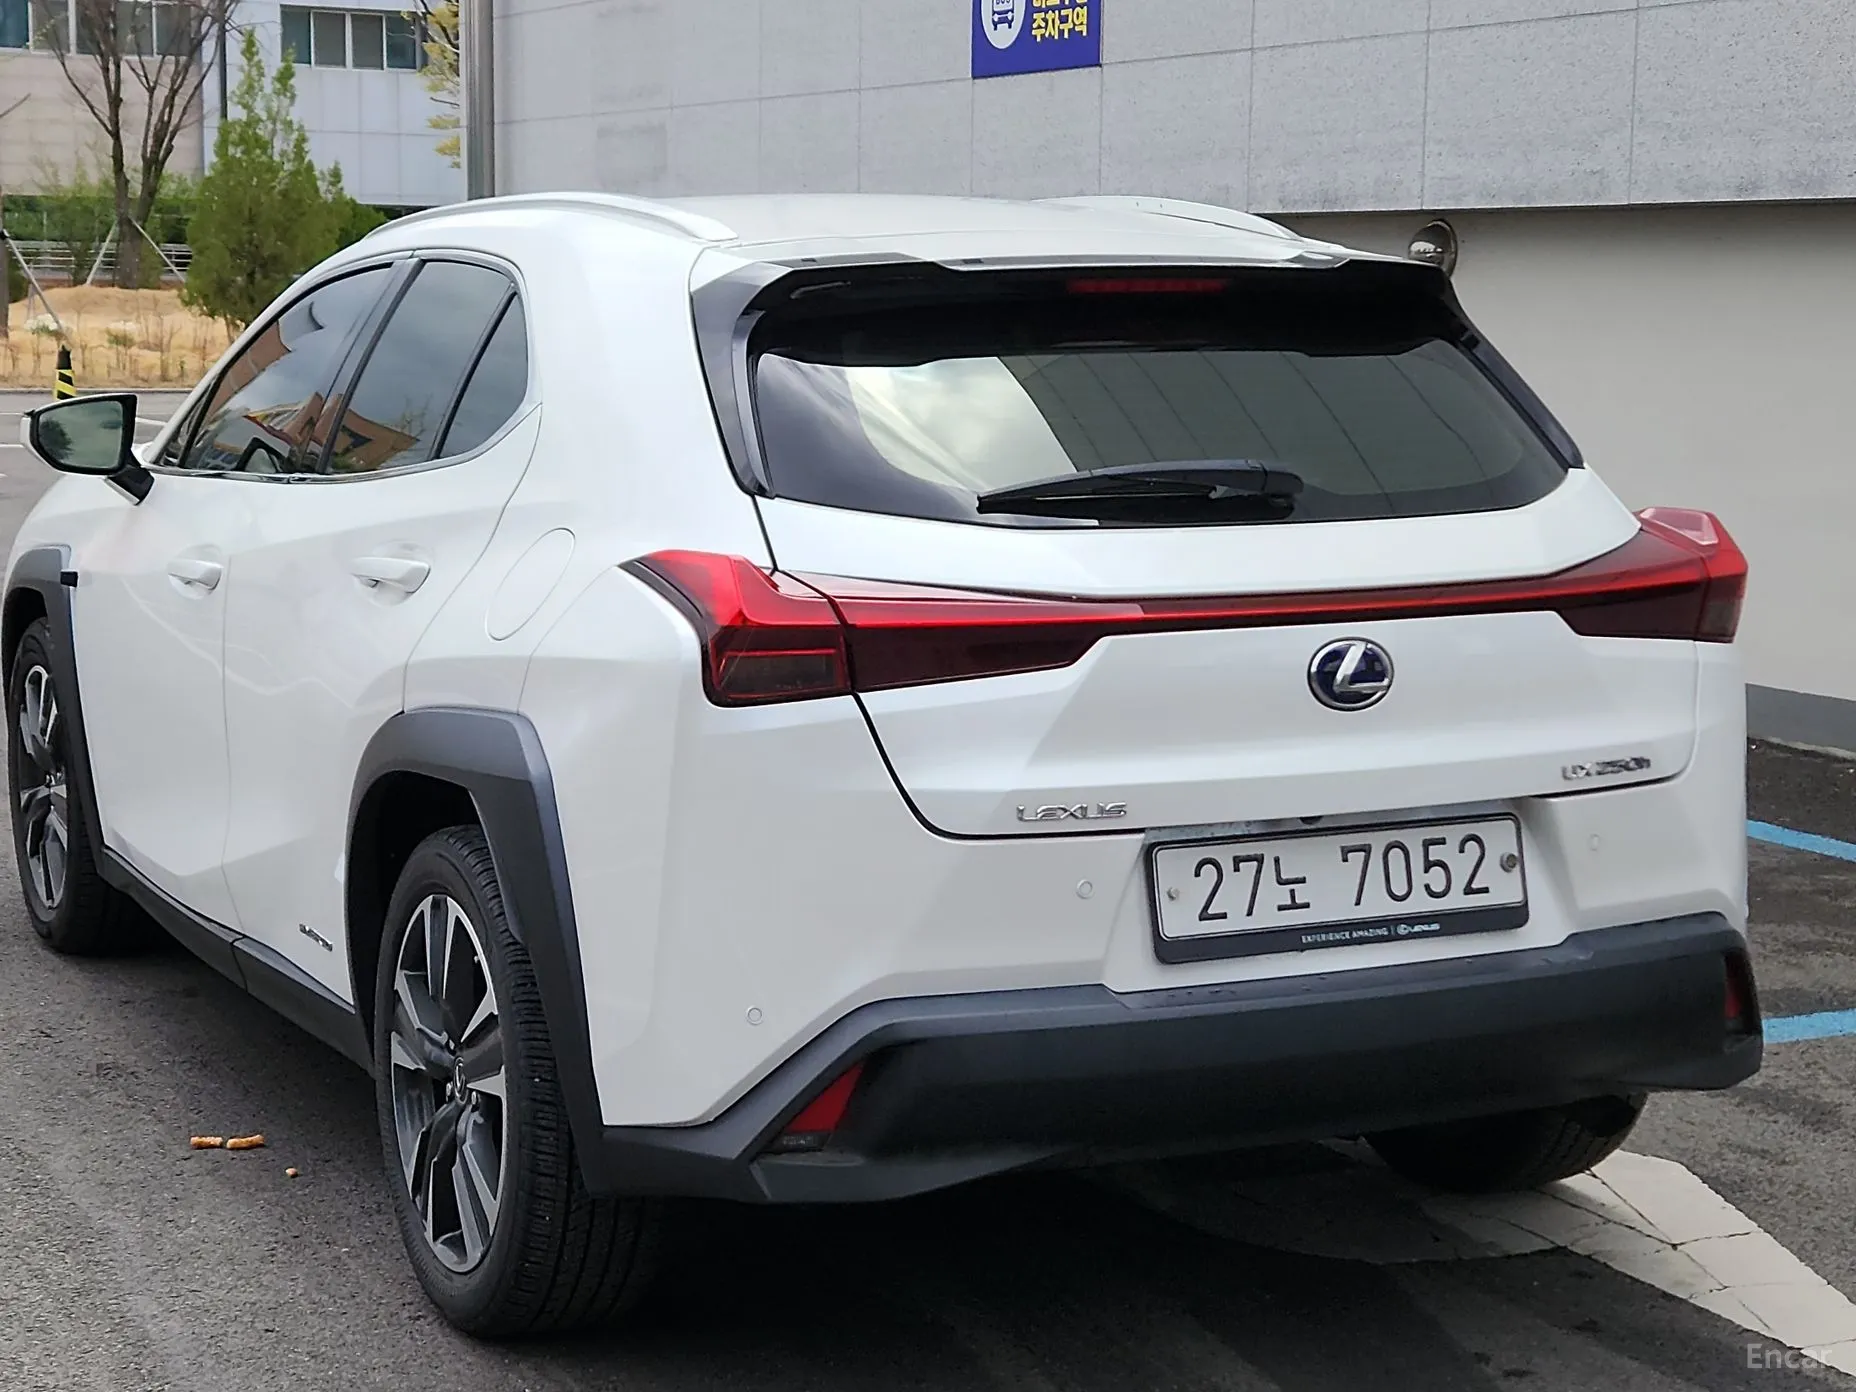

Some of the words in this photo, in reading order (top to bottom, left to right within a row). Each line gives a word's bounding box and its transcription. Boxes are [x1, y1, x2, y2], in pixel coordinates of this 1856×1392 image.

[1031, 6, 1088, 42] 주차구역
[1017, 802, 1126, 822] LEXUS
[1340, 833, 1490, 906] 7052
[1301, 931, 1350, 944] EXPERIENCE
[1351, 927, 1389, 938] AMAZING
